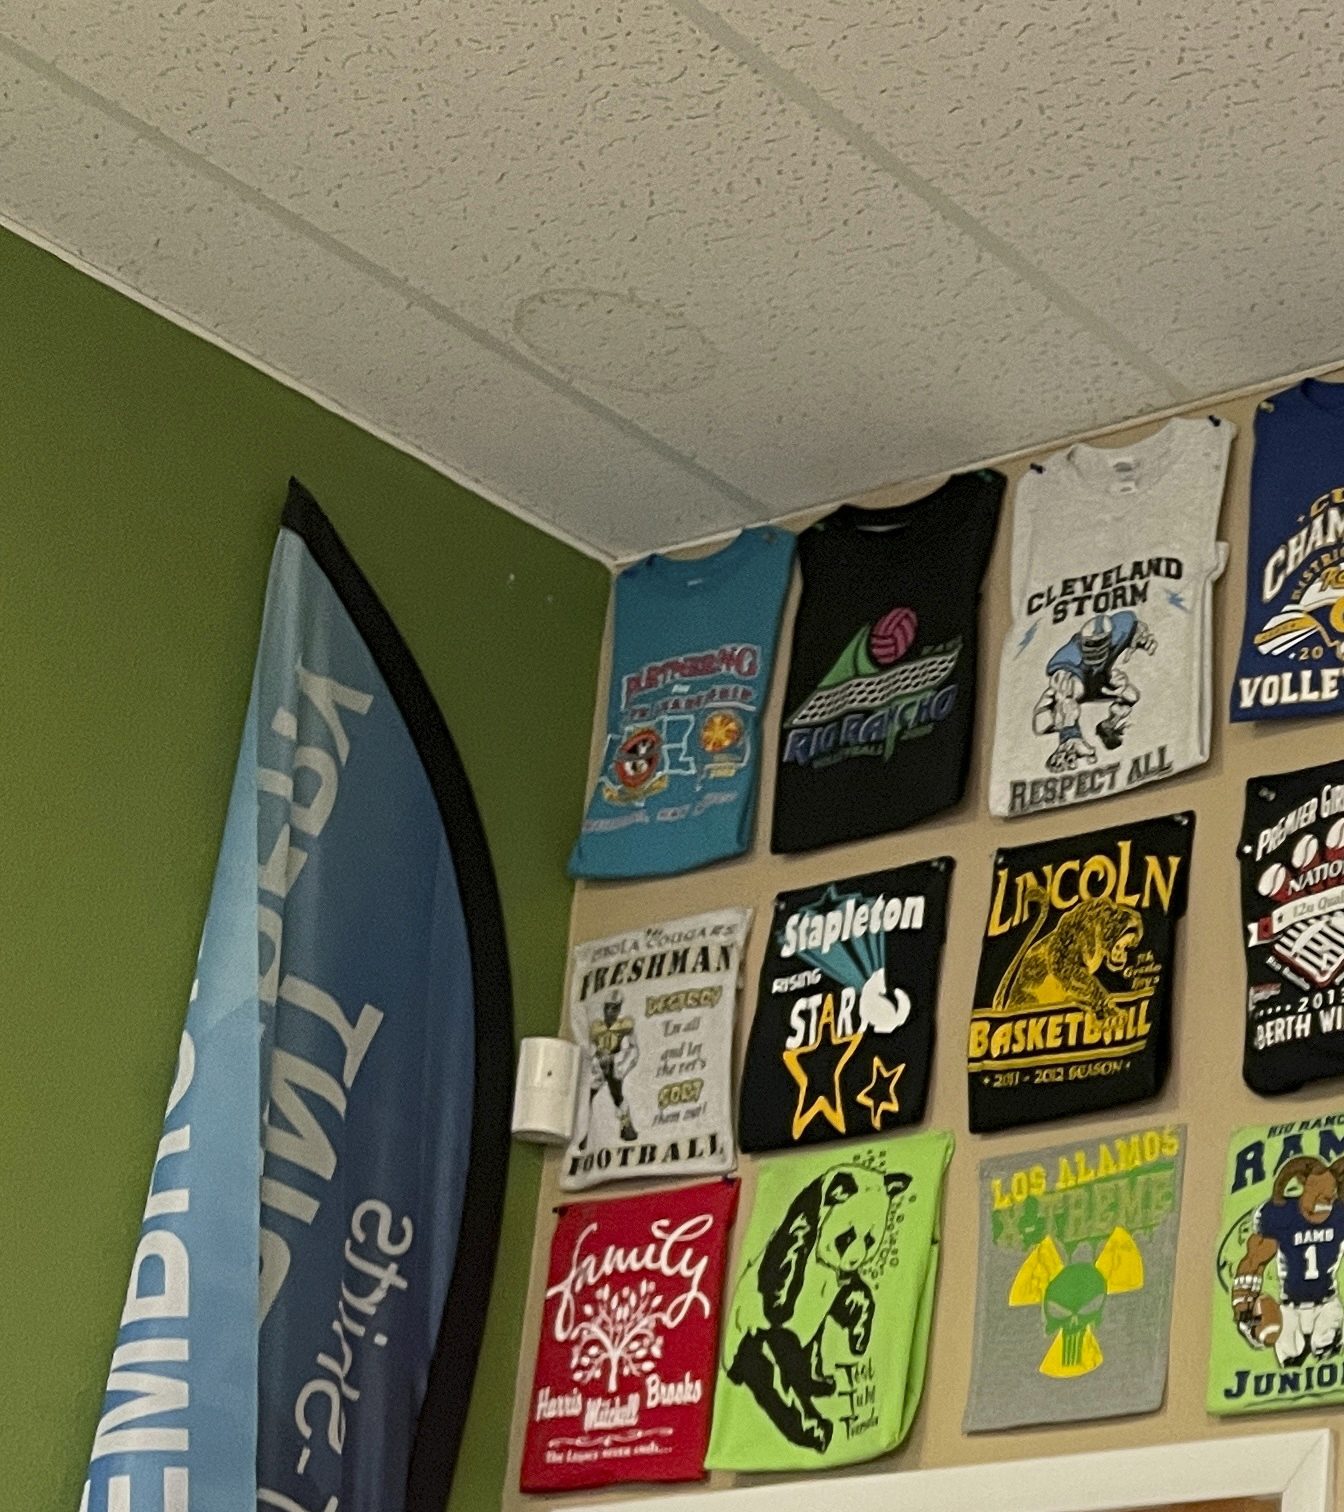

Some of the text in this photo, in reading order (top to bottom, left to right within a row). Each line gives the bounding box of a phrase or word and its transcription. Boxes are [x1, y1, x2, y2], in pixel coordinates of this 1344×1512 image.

[1025, 556, 1184, 617] CLEVELAND
[1051, 580, 1152, 626] STORM
[1008, 745, 1175, 814] RESPECT ALL
[985, 839, 1181, 938] LINCOLN
[780, 893, 926, 959] Stapleton
[578, 943, 734, 1003] FRESHMAN
[568, 1134, 724, 1178] FOOTBALL
[990, 1127, 1181, 1210] LOS ALAMOS
[544, 1213, 715, 1343] family
